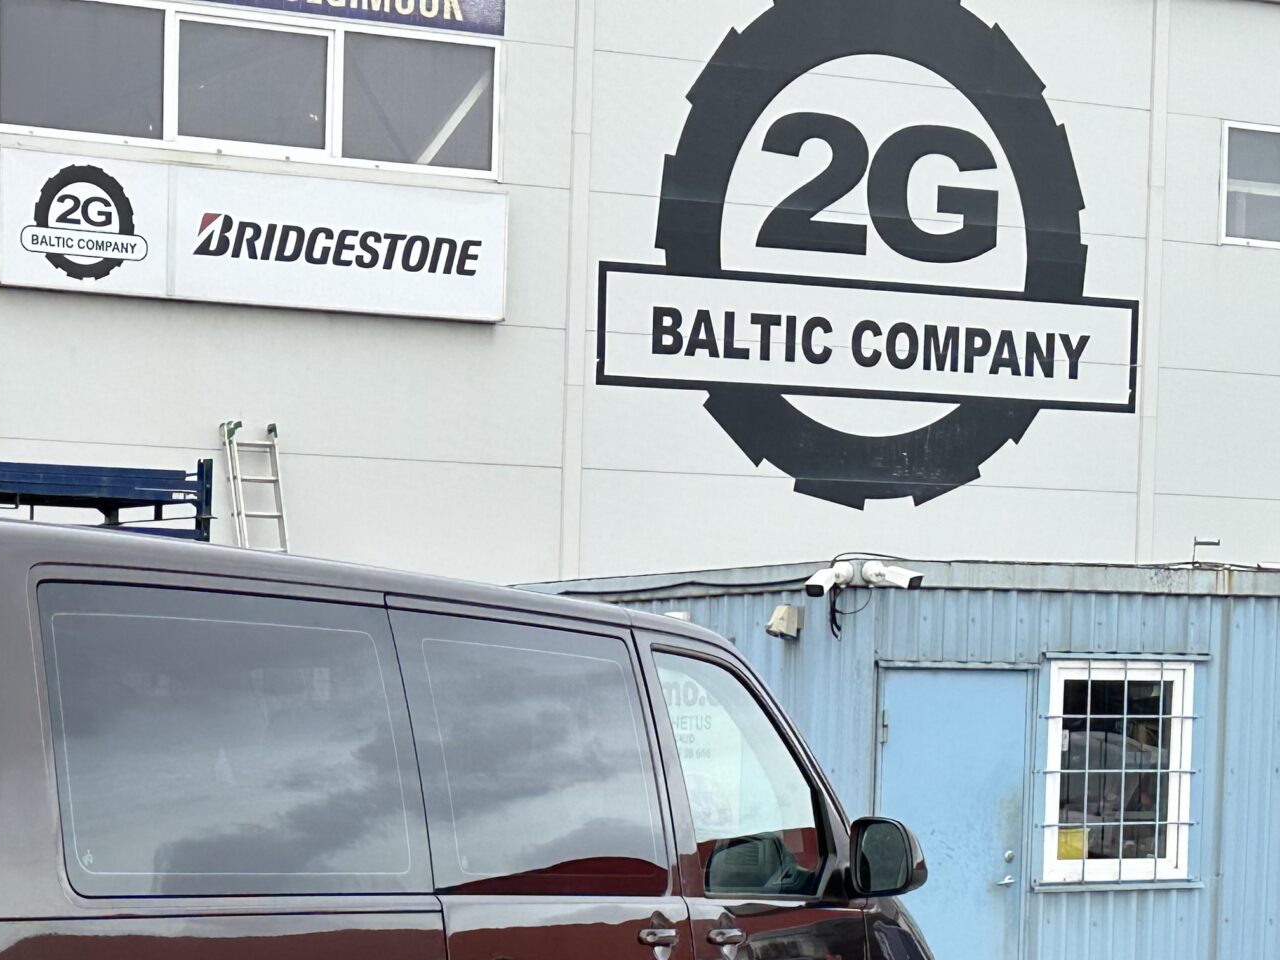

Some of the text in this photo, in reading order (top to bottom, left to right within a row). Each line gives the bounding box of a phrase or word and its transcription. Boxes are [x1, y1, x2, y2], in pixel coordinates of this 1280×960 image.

[55, 193, 113, 227] 2G
[755, 111, 999, 264] 2G
[31, 234, 137, 254] BALTIC COMPANY
[192, 212, 483, 277] BRIDGESTONE
[651, 305, 1091, 380] BALTIC COMPANY
